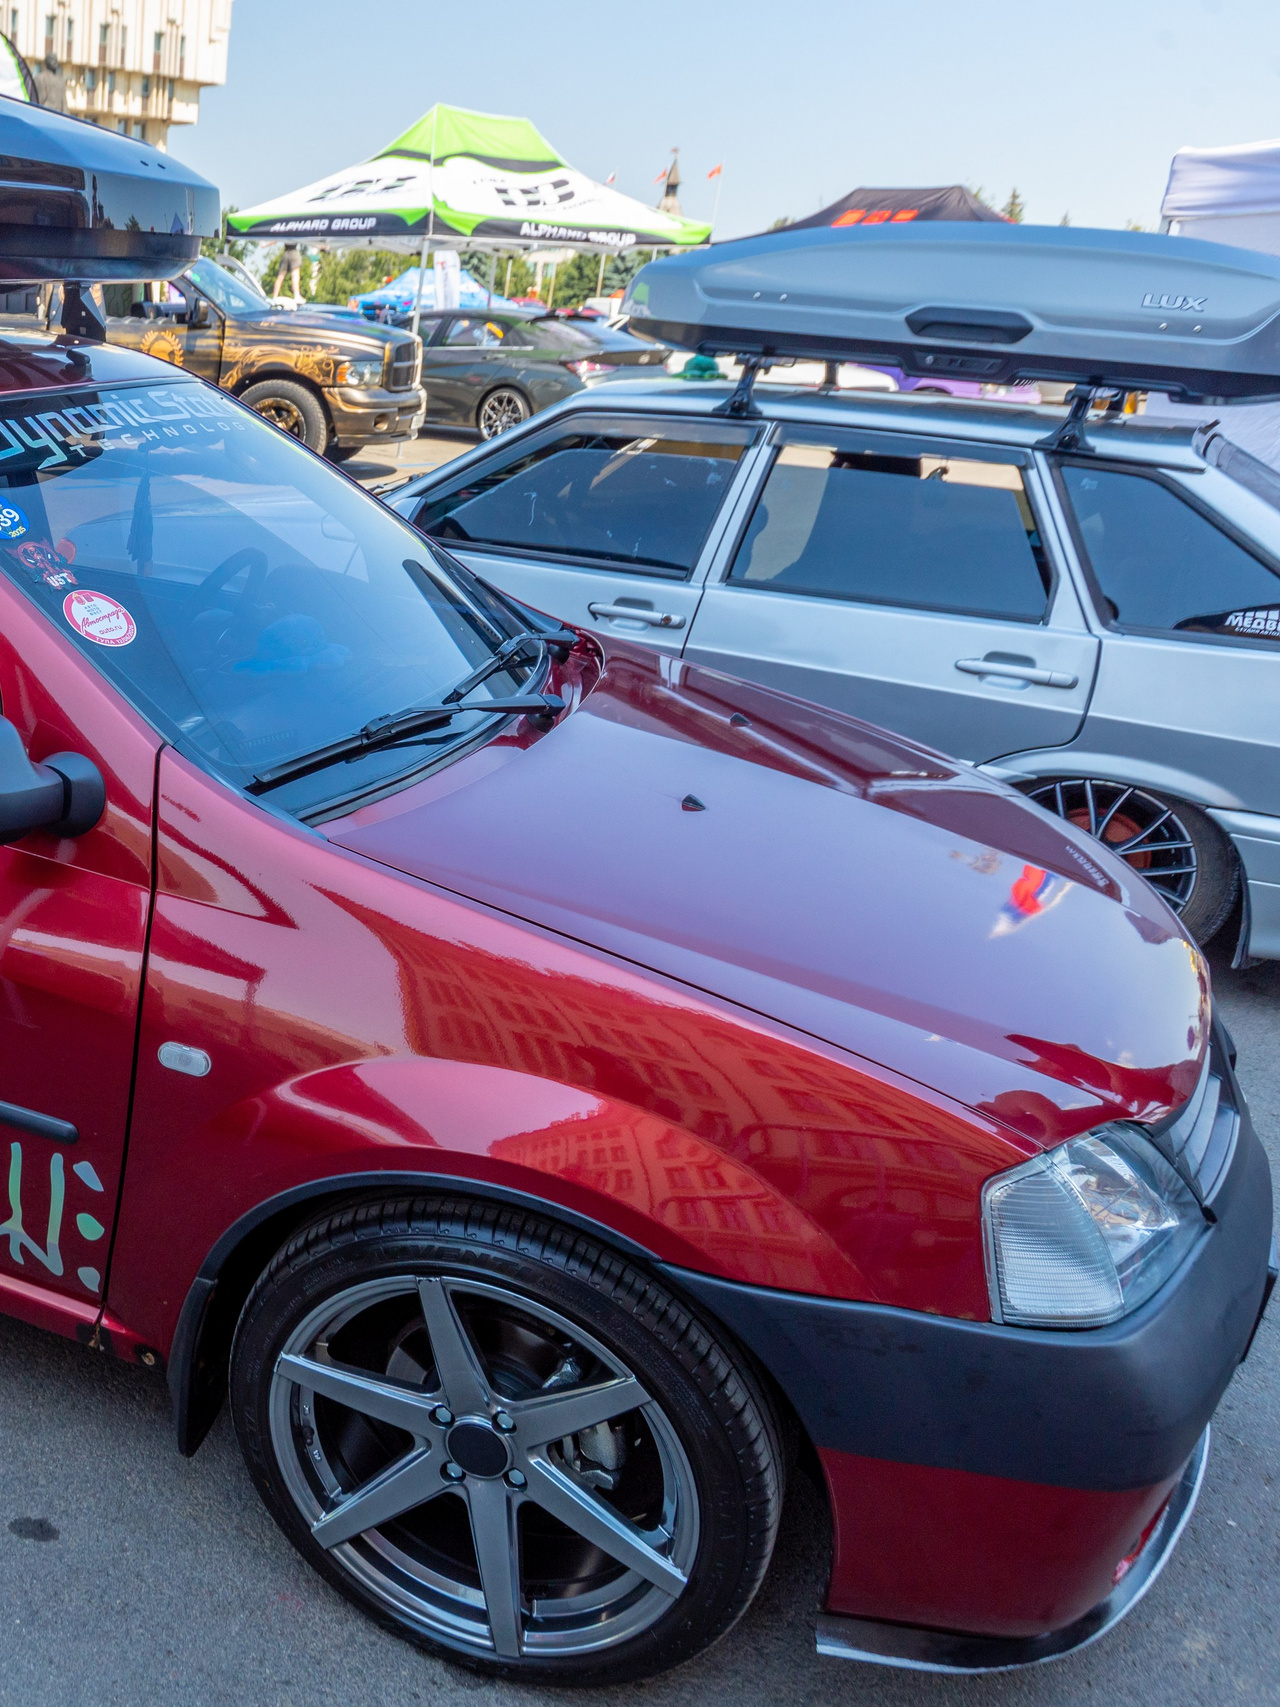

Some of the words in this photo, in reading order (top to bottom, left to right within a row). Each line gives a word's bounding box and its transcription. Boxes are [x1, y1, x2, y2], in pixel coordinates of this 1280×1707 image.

[270, 218, 329, 233] ALPHARD
[330, 217, 377, 231] GROUP
[1141, 292, 1208, 313] LUX
[99, 624, 123, 635] auto.ru
[95, 636, 116, 645] ТУЛА
